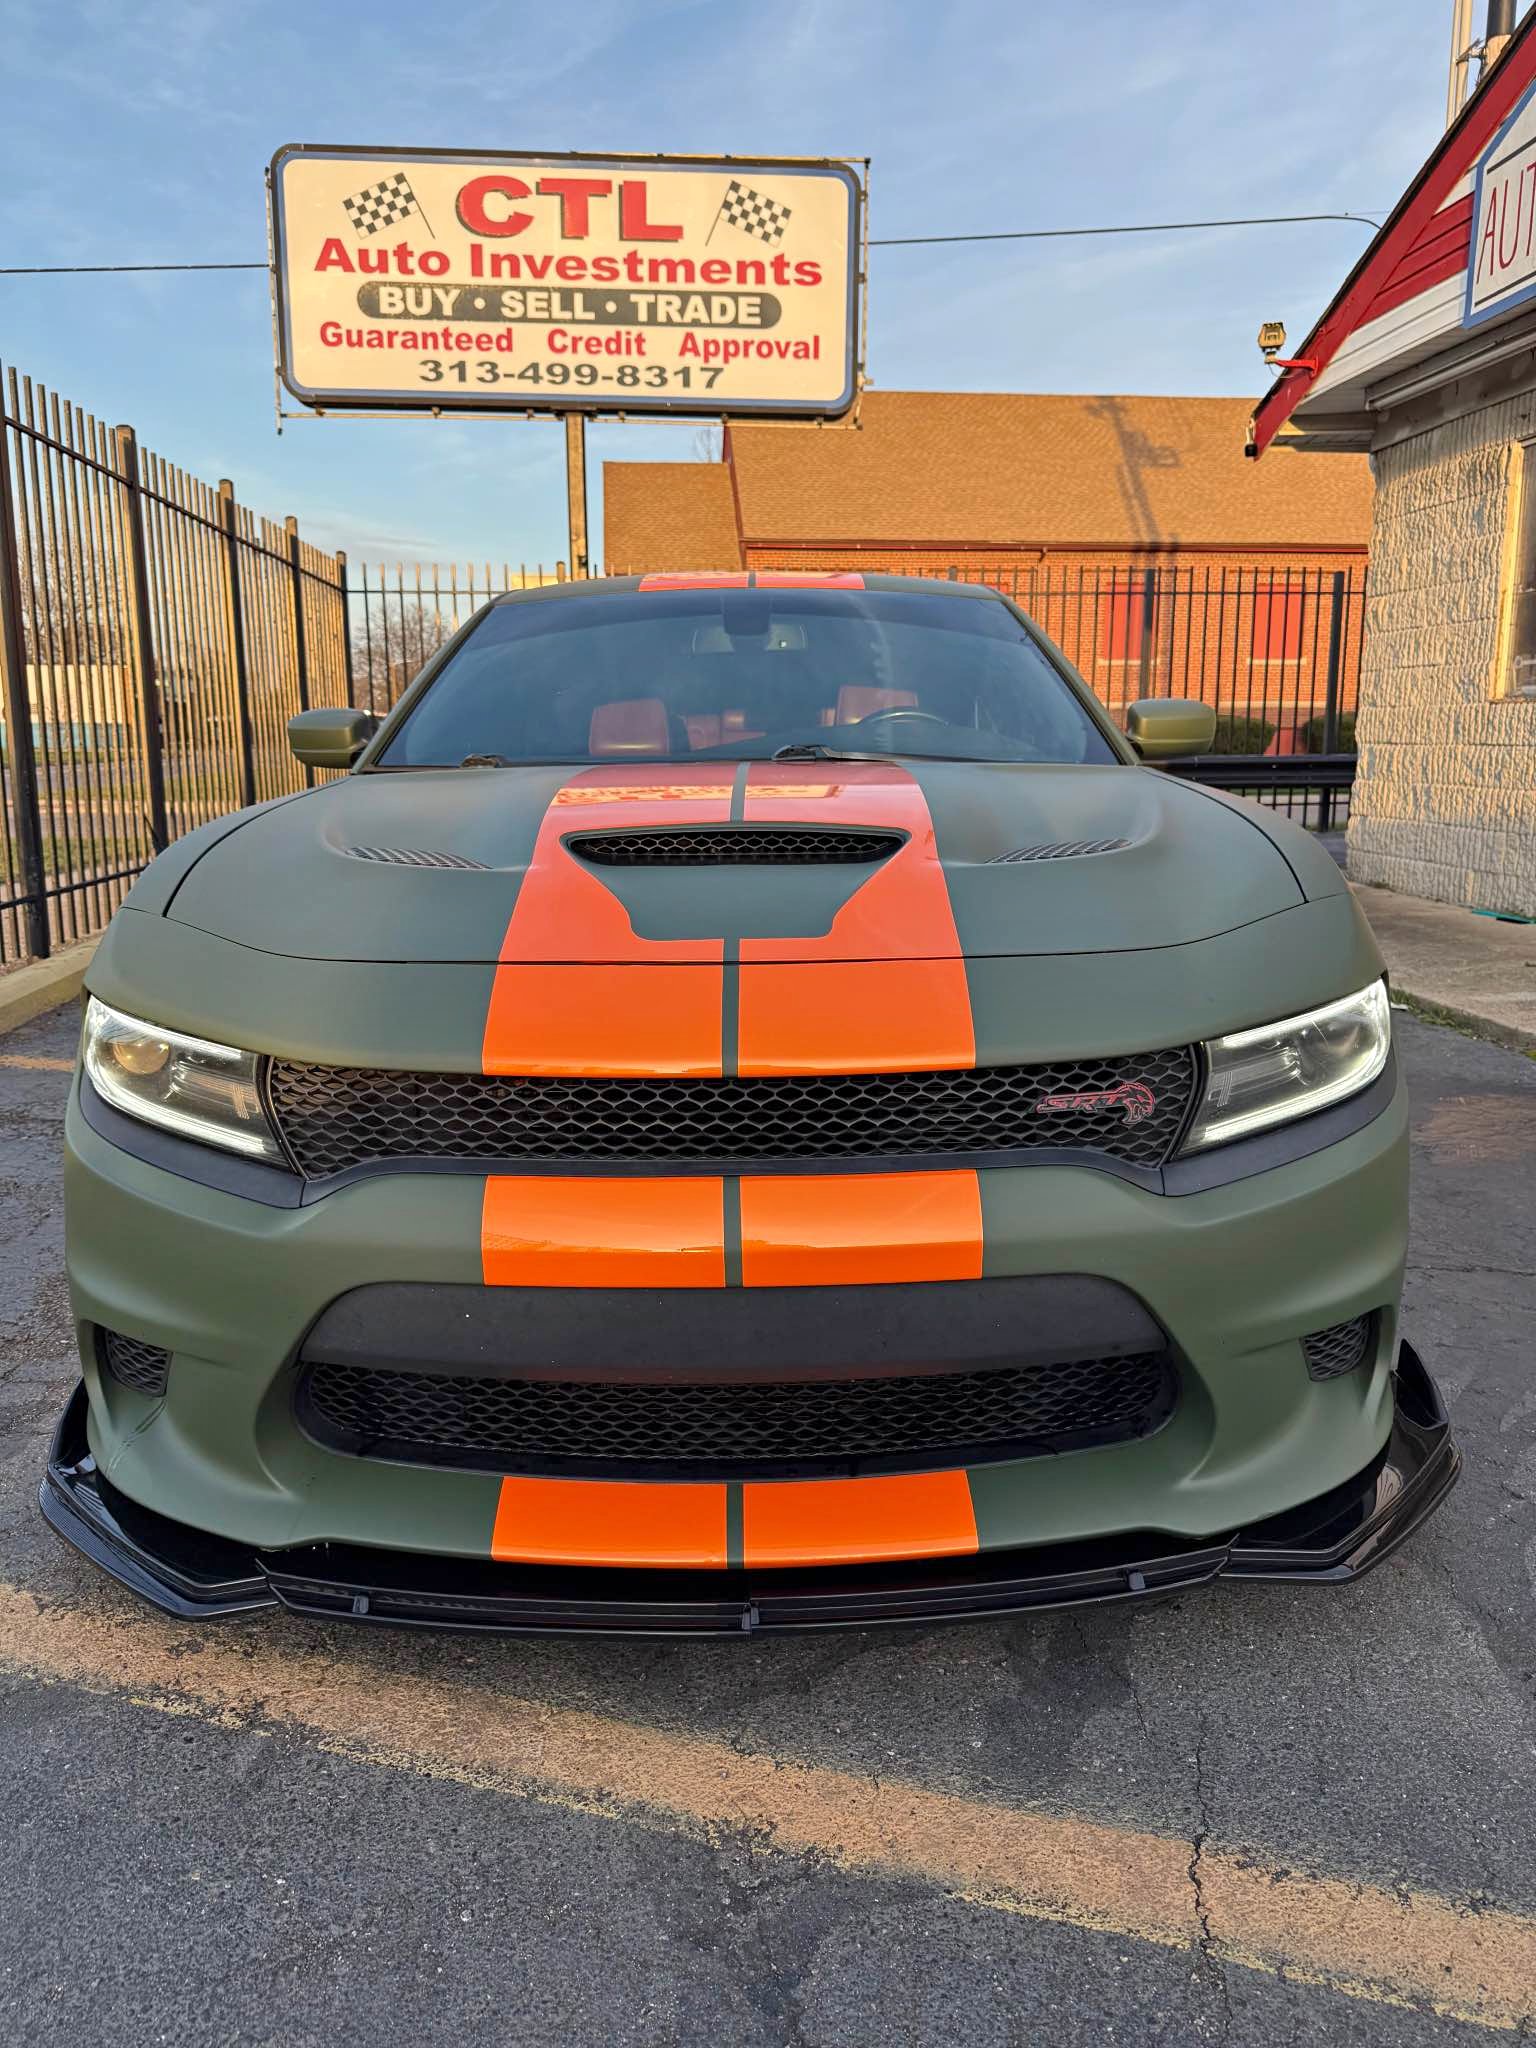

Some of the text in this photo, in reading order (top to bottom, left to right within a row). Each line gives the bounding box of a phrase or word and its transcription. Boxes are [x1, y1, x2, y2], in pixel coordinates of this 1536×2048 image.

[455, 175, 684, 242] CTL
[314, 237, 822, 286] Auto Investments
[379, 286, 762, 325] BUY SELL TRADE
[319, 321, 821, 363] Guaranteed Credit Approval
[419, 360, 725, 389] 313-499-8317
[1036, 1094, 1126, 1113] SRT
